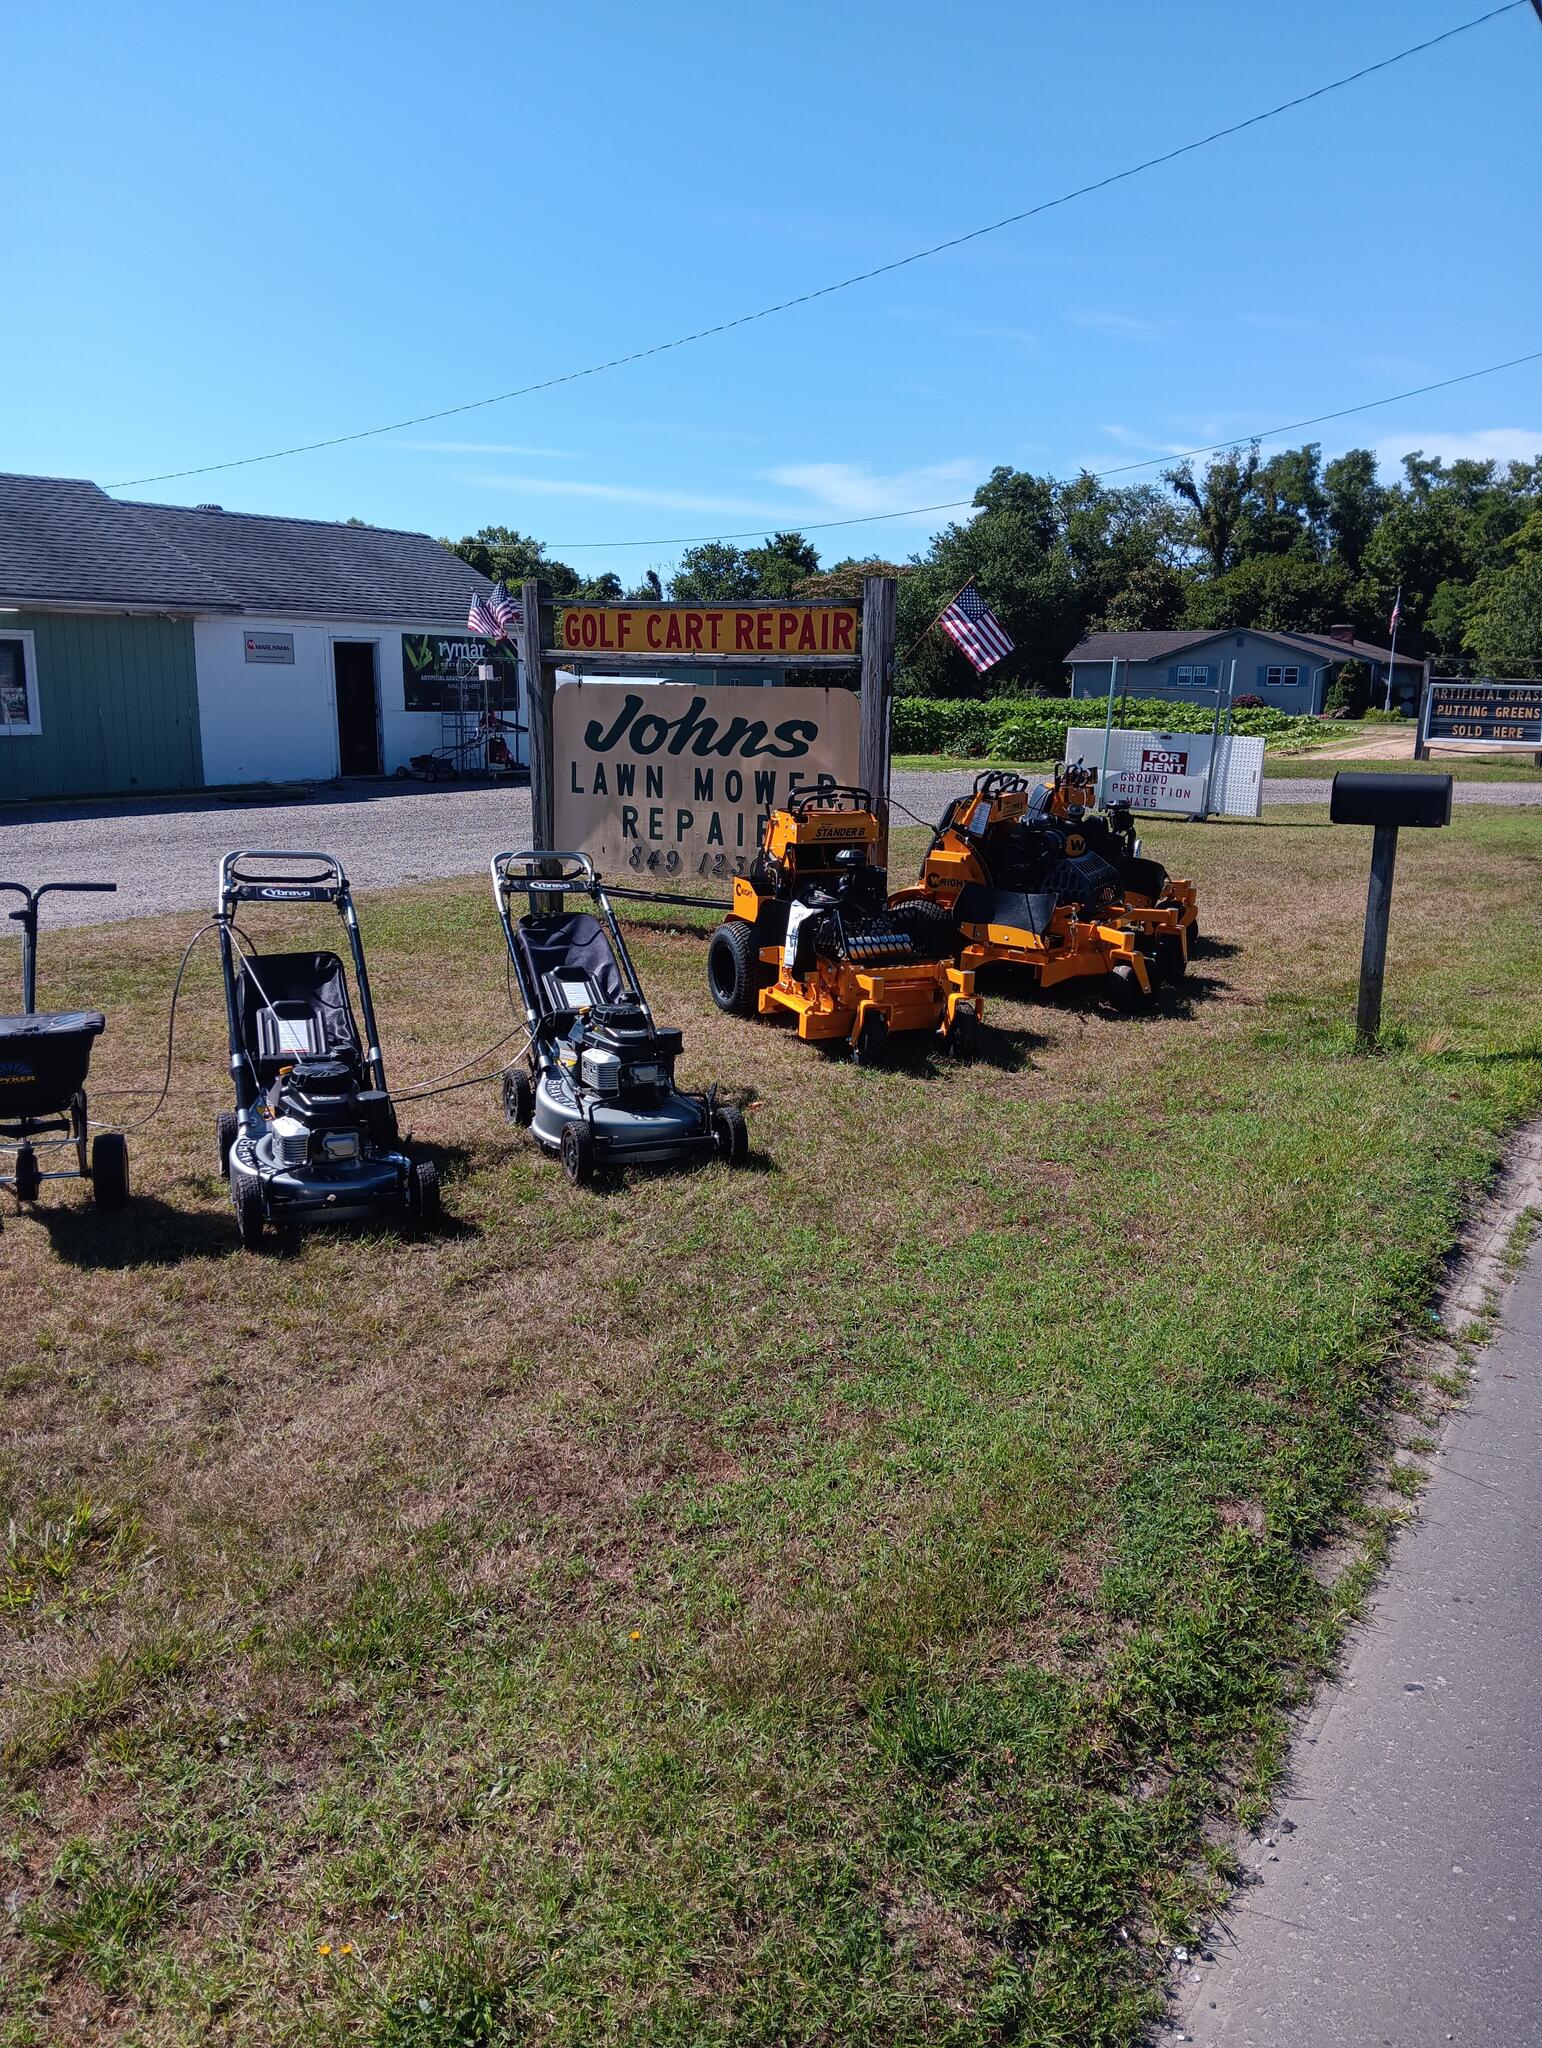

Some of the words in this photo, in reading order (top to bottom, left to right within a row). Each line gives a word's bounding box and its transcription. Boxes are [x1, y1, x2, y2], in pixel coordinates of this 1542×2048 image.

[565, 613, 632, 648] GOLF
[646, 613, 723, 649] CART
[735, 612, 854, 650] REPAIR
[438, 640, 485, 661] rymar
[1434, 688, 1502, 699] ARTIFICIAL
[1508, 690, 1542, 701] GRAS
[1437, 704, 1488, 717] PUTTING
[1495, 706, 1540, 719] GREENS
[584, 694, 819, 757] Johns
[1452, 725, 1483, 737] SOLD
[1493, 726, 1524, 738] HERE
[1149, 752, 1180, 762] FOR
[1143, 761, 1185, 774] RENT
[571, 761, 663, 798] LAWN
[695, 768, 836, 808] MOWER
[1120, 773, 1168, 785] GROUND
[1112, 783, 1192, 799] PROTECTION
[1127, 797, 1157, 808] MATS
[816, 827, 857, 837] STANDER
[628, 846, 678, 872] 849
